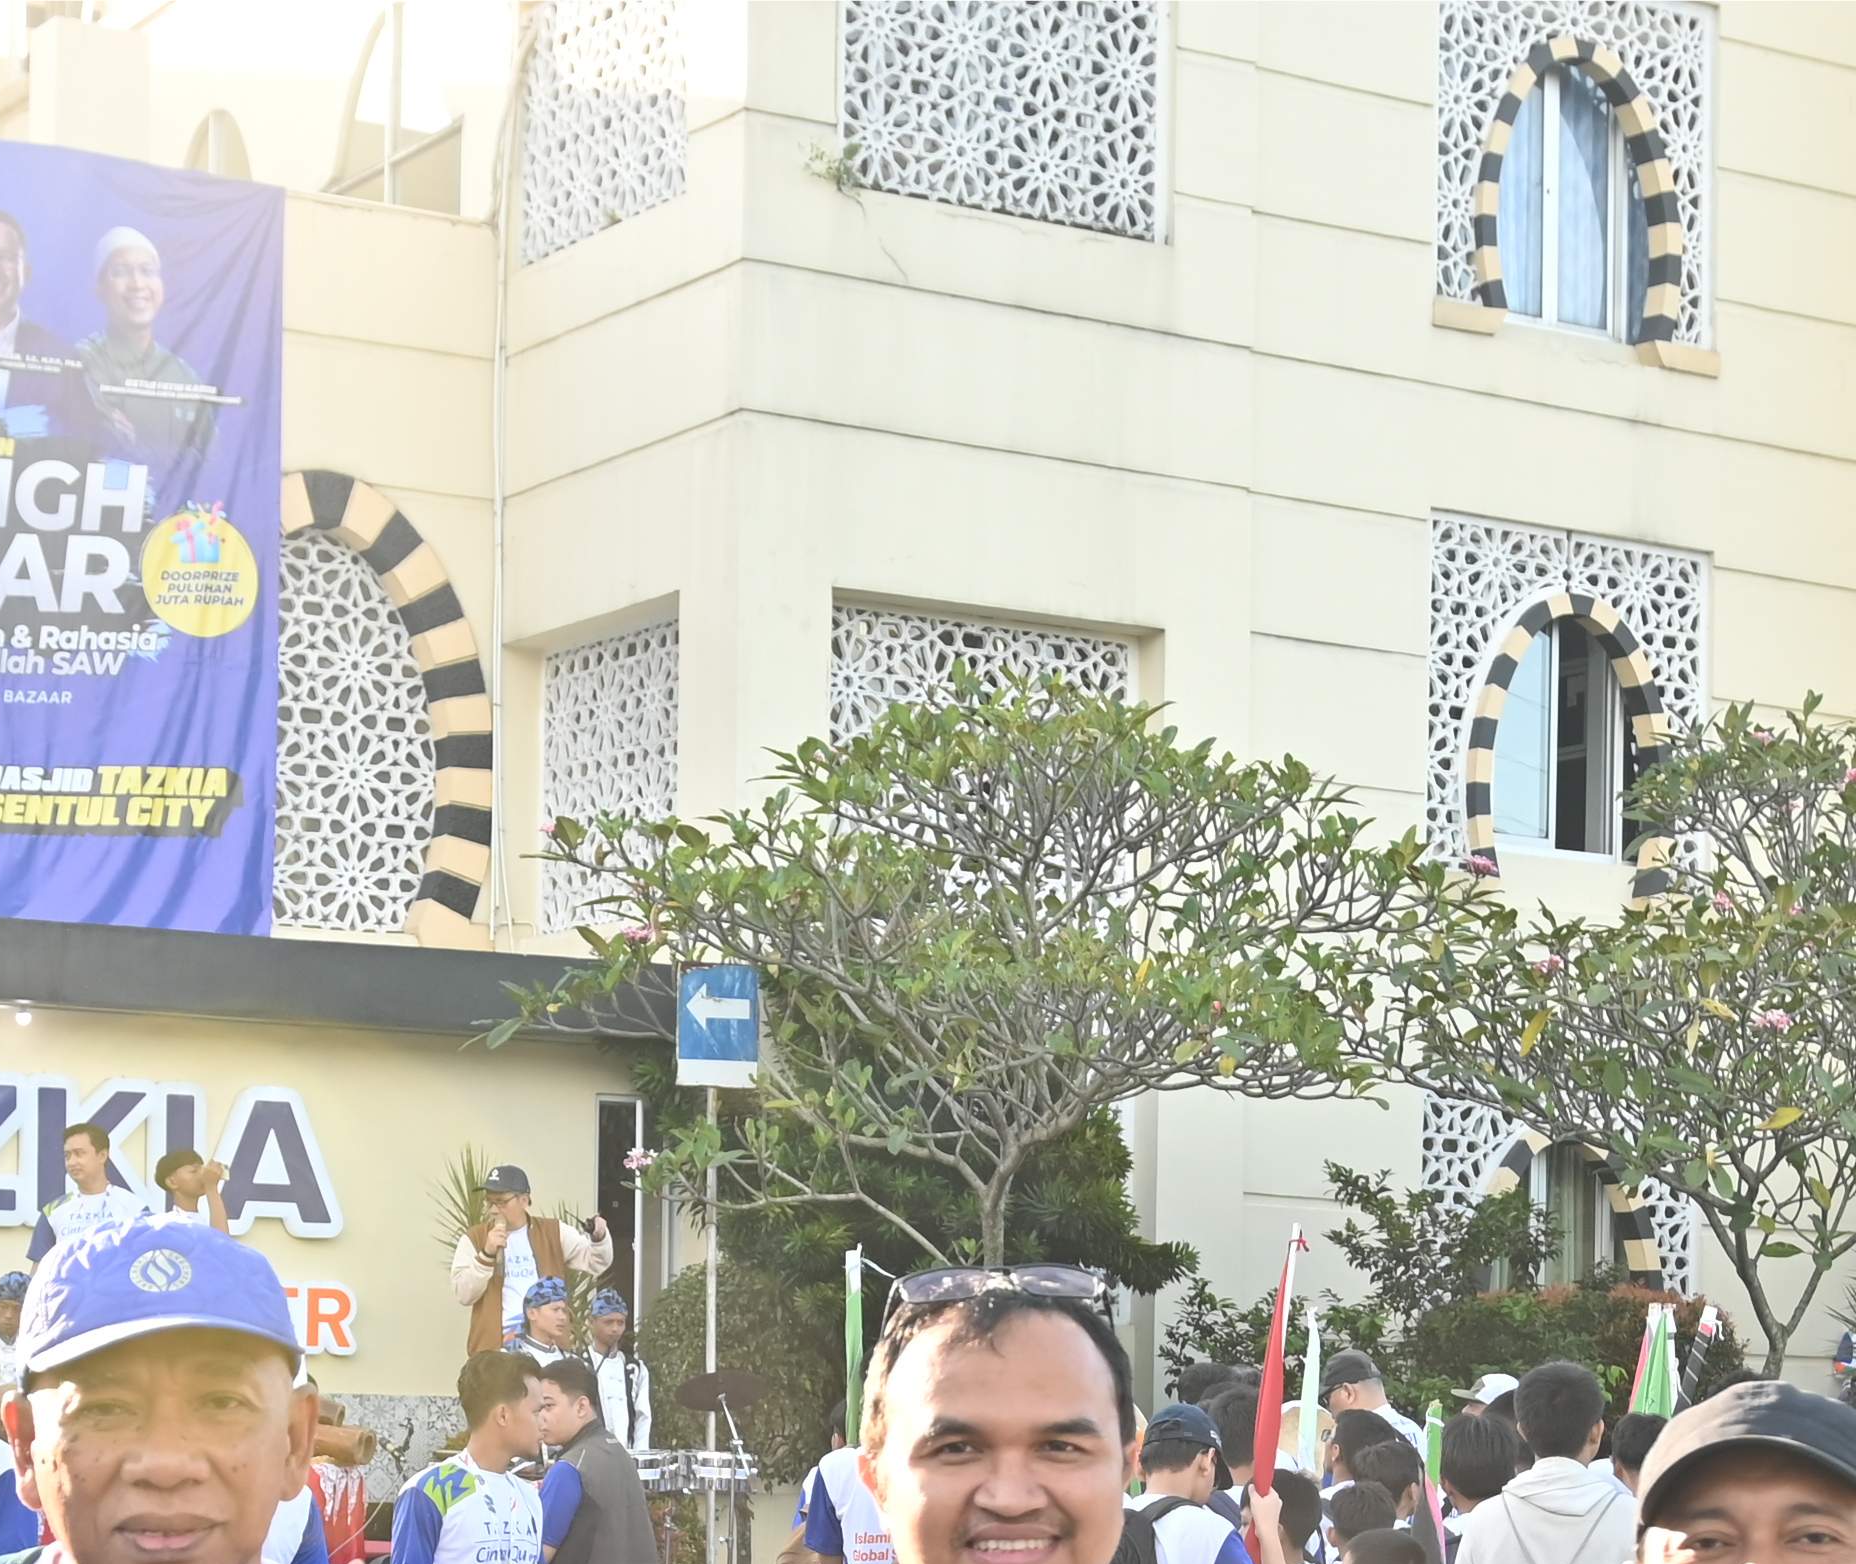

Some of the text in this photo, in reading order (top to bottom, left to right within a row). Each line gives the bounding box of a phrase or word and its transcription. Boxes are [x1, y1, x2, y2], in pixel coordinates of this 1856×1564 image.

[159, 568, 241, 585] DOORPRIZE
[165, 581, 234, 596] PULUHAN
[154, 593, 245, 609] JUTA RUPIAH
[9, 624, 33, 648] &
[38, 623, 158, 653] Rahasia
[51, 651, 126, 678] SAW
[1, 689, 74, 707] BAZAAR
[97, 766, 228, 798] TAZKIA
[124, 796, 217, 829] CITY
